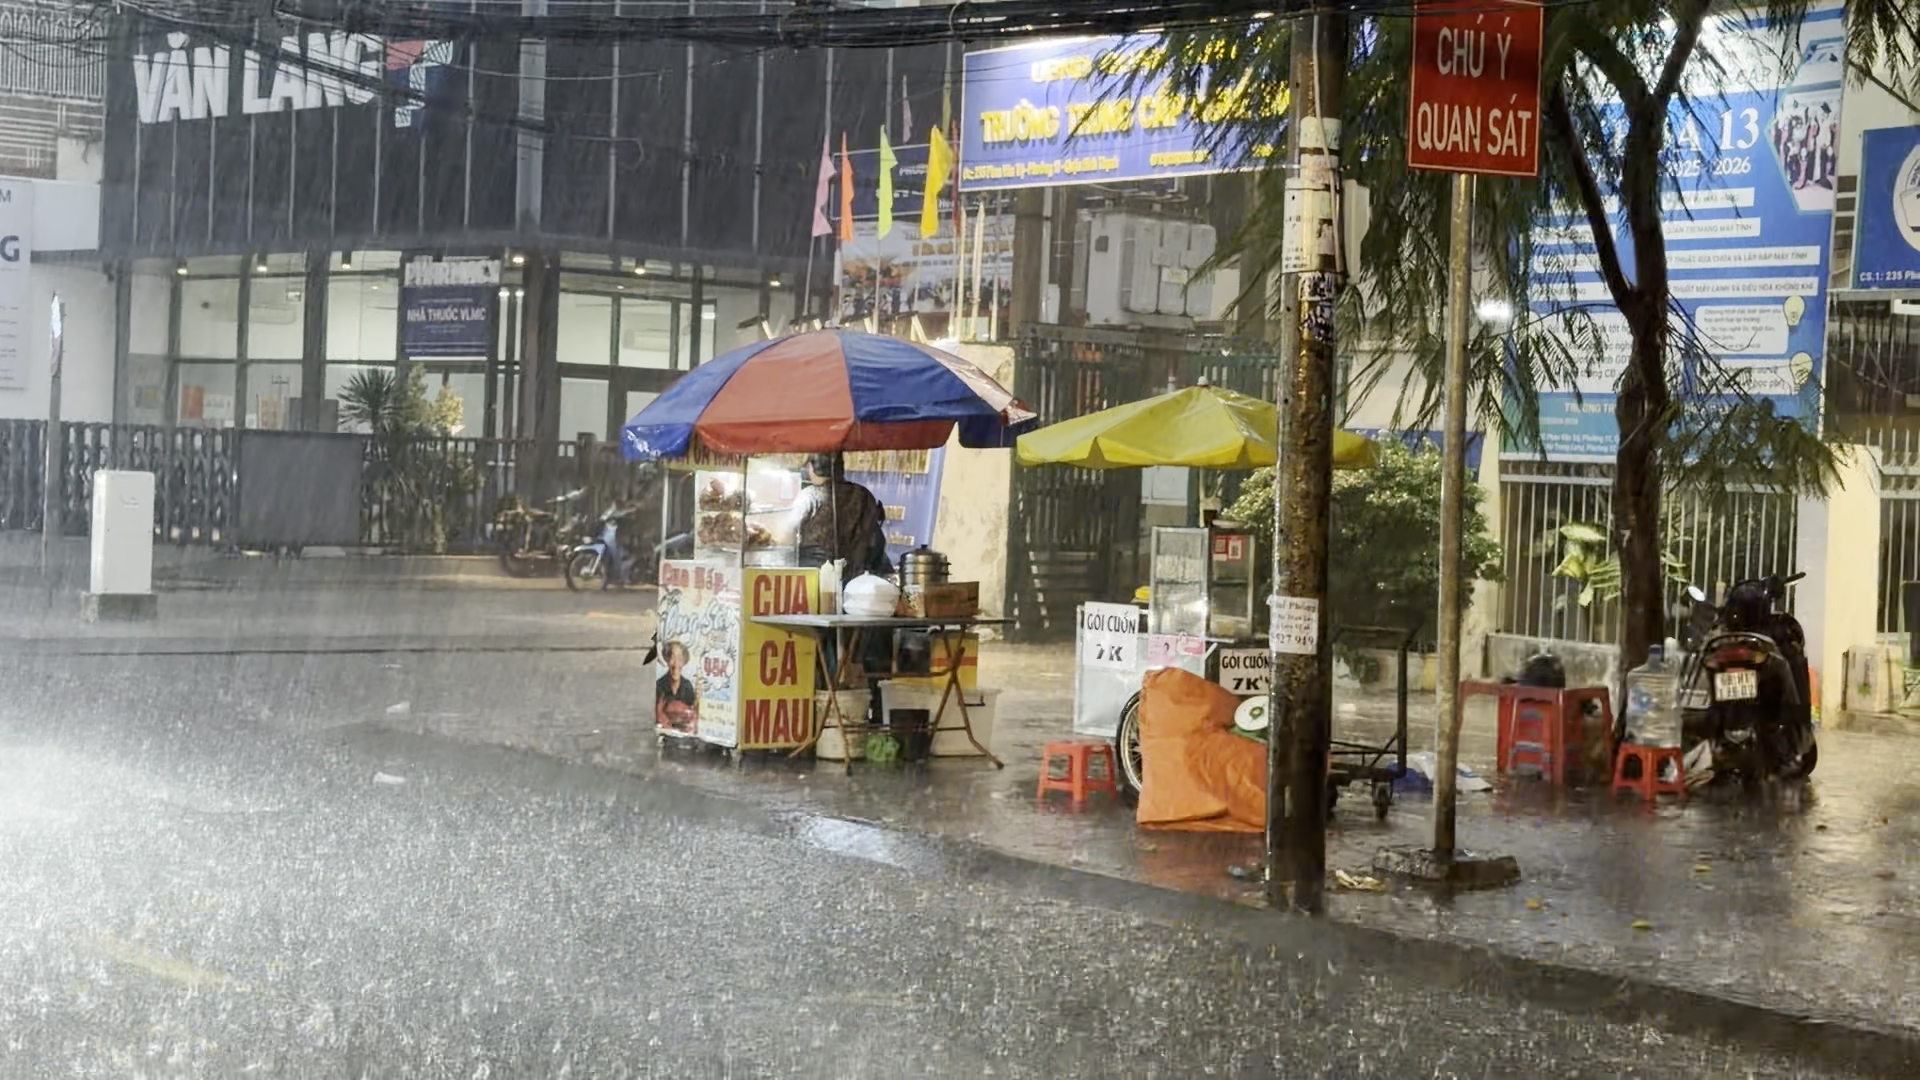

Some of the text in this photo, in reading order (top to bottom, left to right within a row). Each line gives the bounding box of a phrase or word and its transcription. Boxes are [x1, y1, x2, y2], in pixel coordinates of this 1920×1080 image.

[1437, 14, 1511, 80] CHÚ Ý
[242, 30, 383, 114] LANG
[1417, 93, 1532, 157] QUAN SÁT
[1720, 107, 1759, 150] 13
[1713, 157, 1751, 175] 2026
[753, 574, 809, 616] CUA
[1107, 611, 1136, 634] CUỐN
[744, 698, 810, 744] MAU
